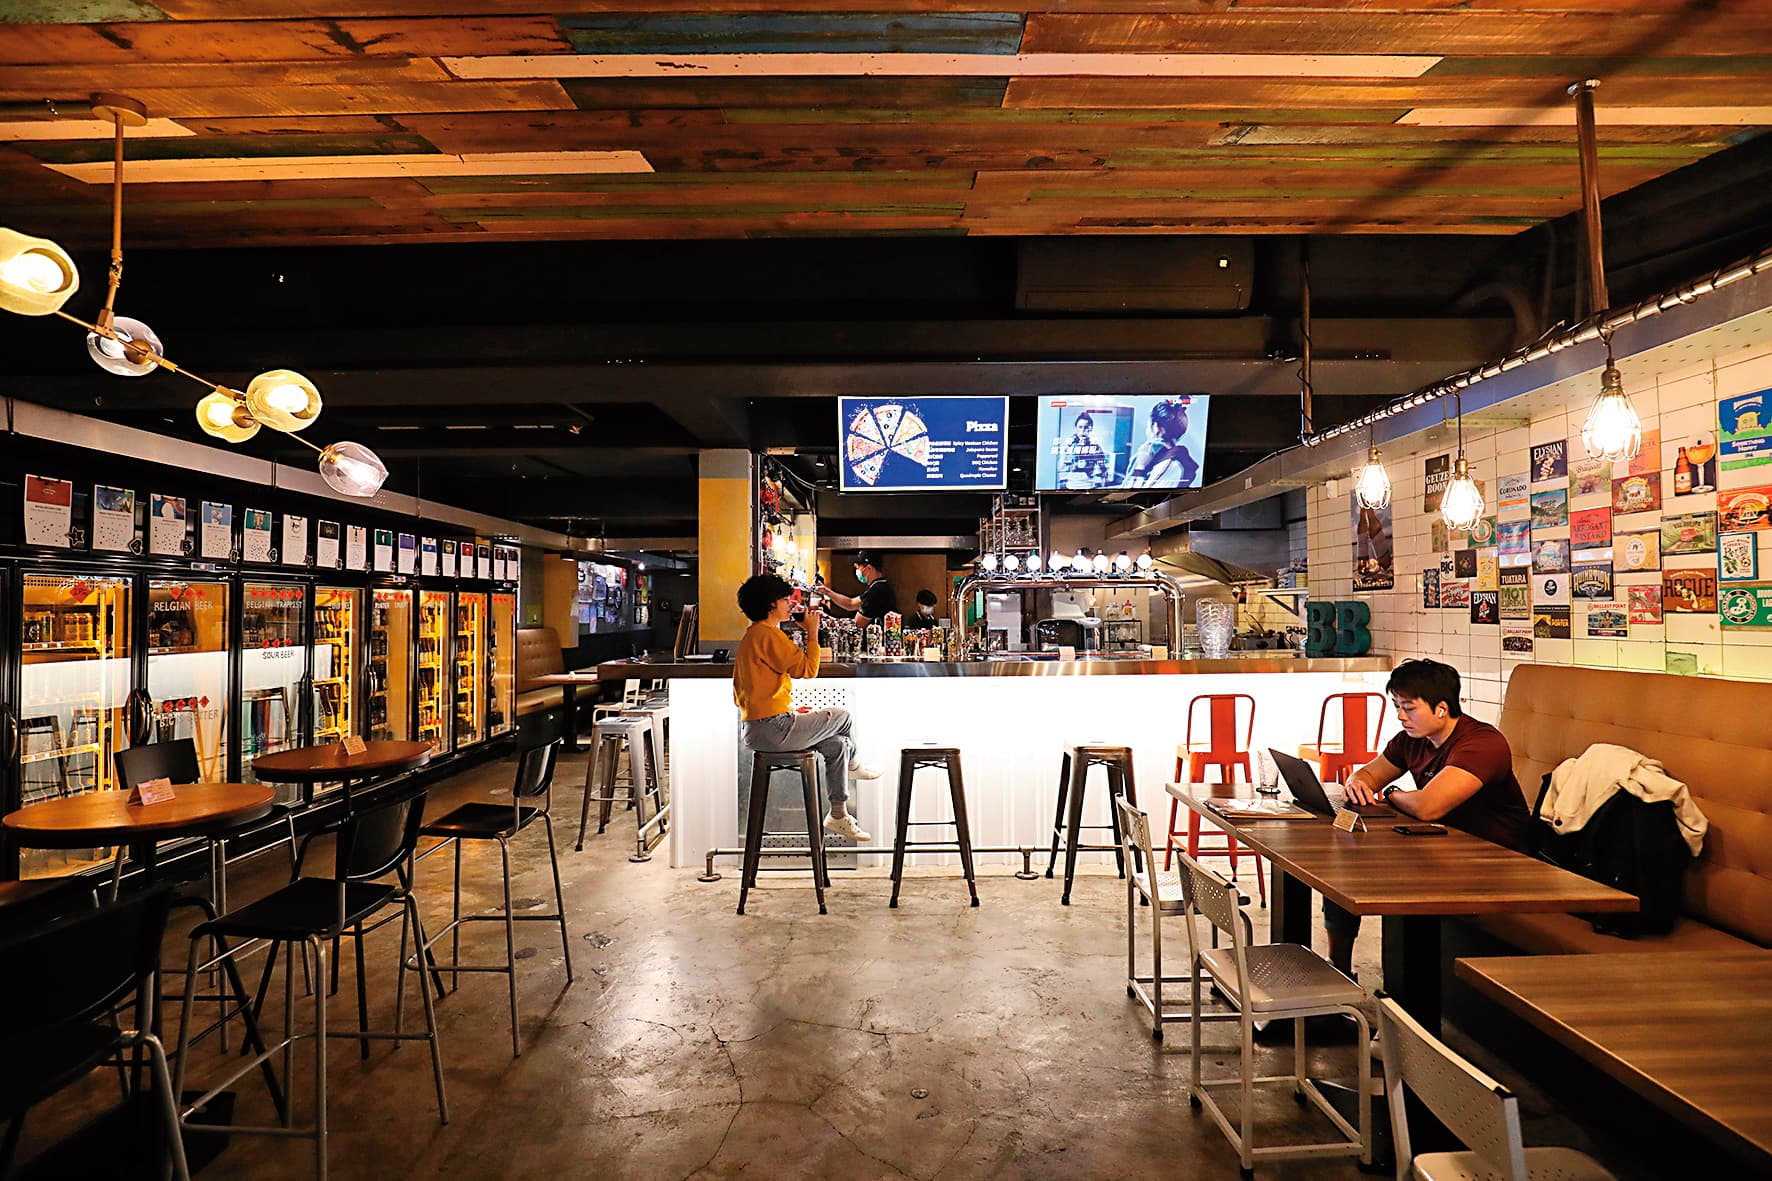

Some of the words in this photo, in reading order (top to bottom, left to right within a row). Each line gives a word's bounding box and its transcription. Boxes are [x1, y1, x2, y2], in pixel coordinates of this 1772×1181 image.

[966, 420, 998, 432] Pizza
[1534, 442, 1563, 460] ELYSIAN
[1425, 471, 1449, 485] GEUZE
[1499, 484, 1527, 496] CORONADO
[1440, 560, 1454, 572] BIG
[1501, 574, 1527, 585] TUATARA
[1501, 587, 1527, 599] MOT
[1664, 577, 1713, 598] ROGUE
[154, 601, 191, 611] BELGIAN
[195, 601, 213, 610] BEER
[246, 601, 273, 609] BELGIAN
[262, 651, 280, 660] SOUR
[281, 650, 295, 659] BEER
